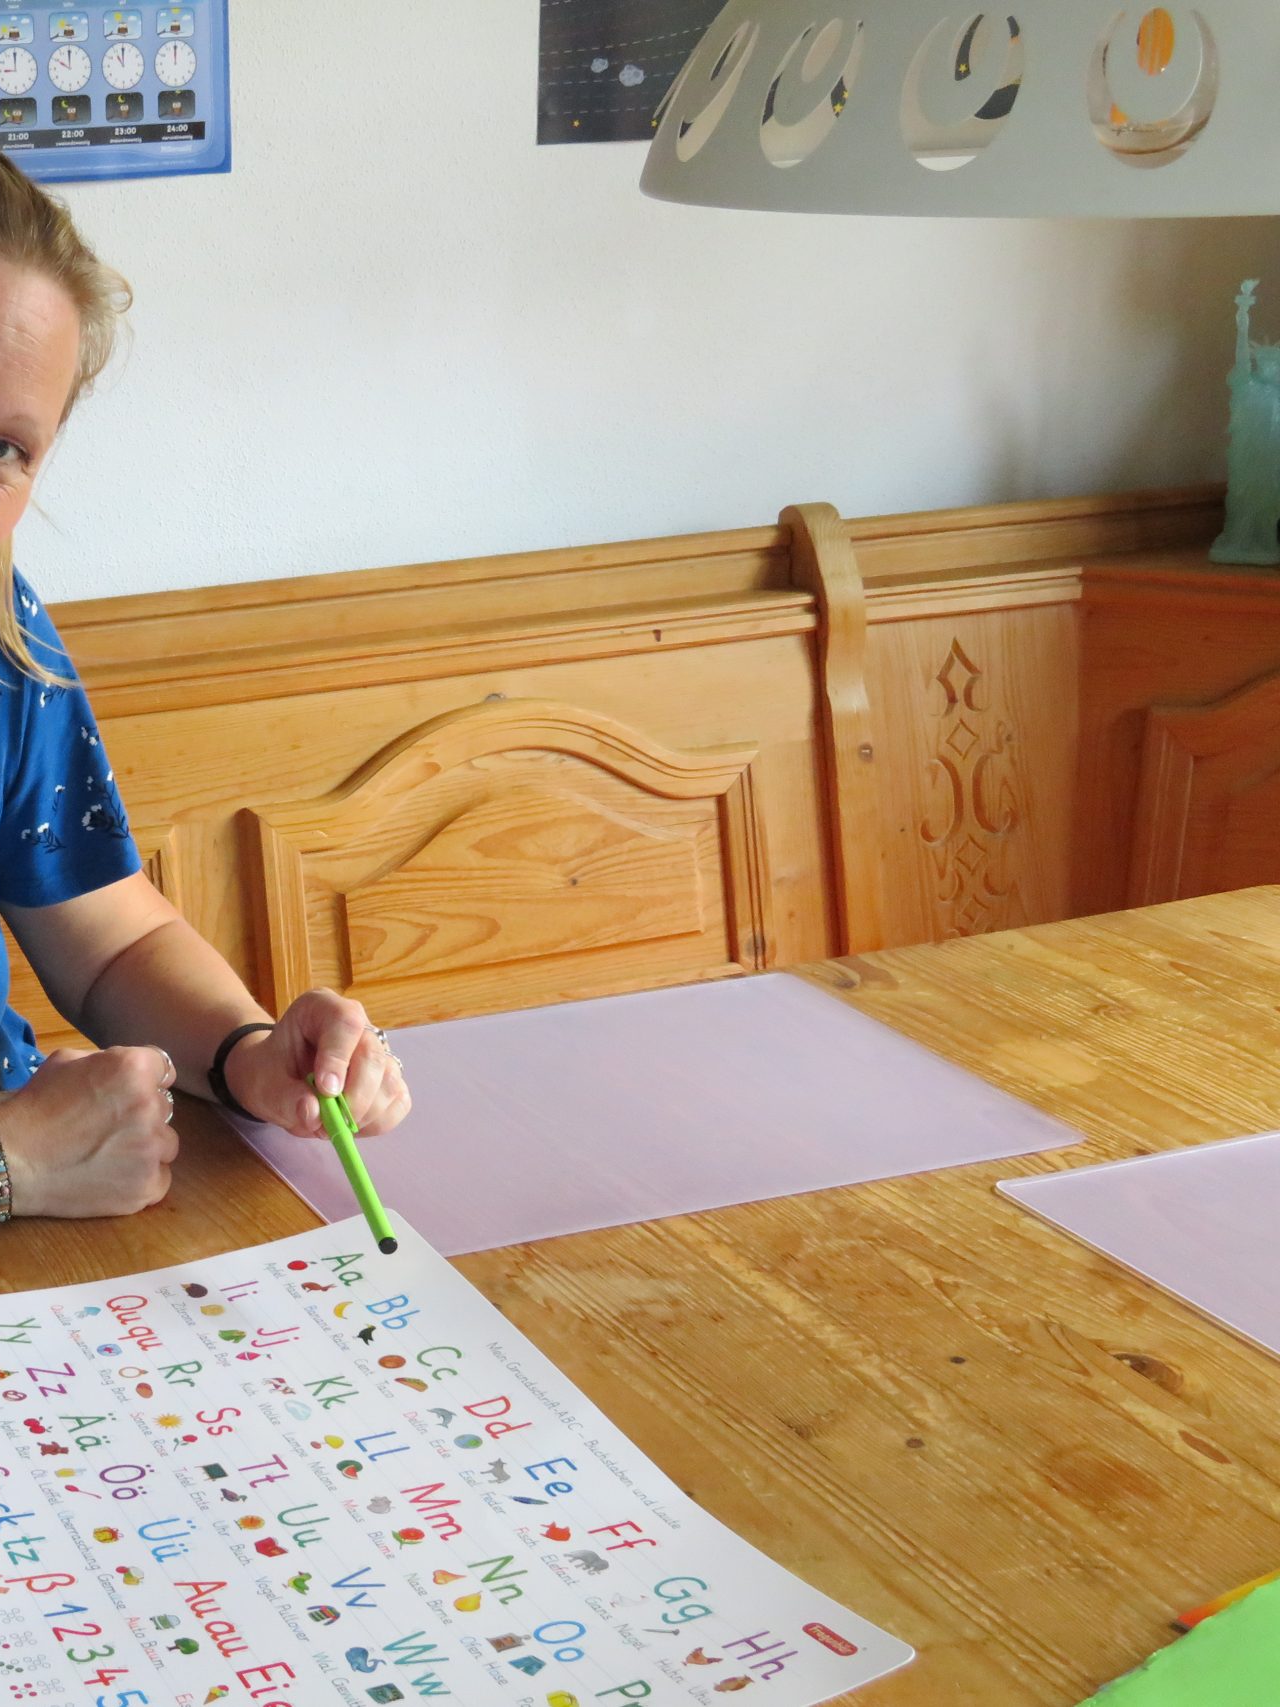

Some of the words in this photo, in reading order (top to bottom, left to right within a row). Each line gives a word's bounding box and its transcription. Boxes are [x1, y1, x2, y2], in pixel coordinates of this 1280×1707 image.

[8, 132, 29, 141] 21:00
[61, 130, 85, 138] 22:00
[167, 124, 188, 133] 24:00
[320, 1253, 364, 1286] Aa
[365, 1294, 420, 1330] Bb
[157, 1360, 203, 1387] Rr
[416, 1346, 462, 1381] Cc
[303, 1375, 360, 1410] Kk
[463, 1395, 533, 1440] Dd
[238, 1454, 290, 1488] Tt
[523, 1457, 578, 1497] Ee
[277, 1503, 330, 1548] Uu
[400, 1482, 463, 1542] Mm
[3, 1535, 47, 1566] tz
[587, 1520, 657, 1551] Ff
[467, 1555, 528, 1605] Nn
[43, 1603, 89, 1617] 1
[653, 1576, 713, 1625] Gg
[52, 1623, 102, 1642] 2
[276, 1603, 311, 1643] Pullover
[66, 1644, 115, 1663] 3
[721, 1630, 799, 1681] Hh
[83, 1669, 129, 1686] 4
